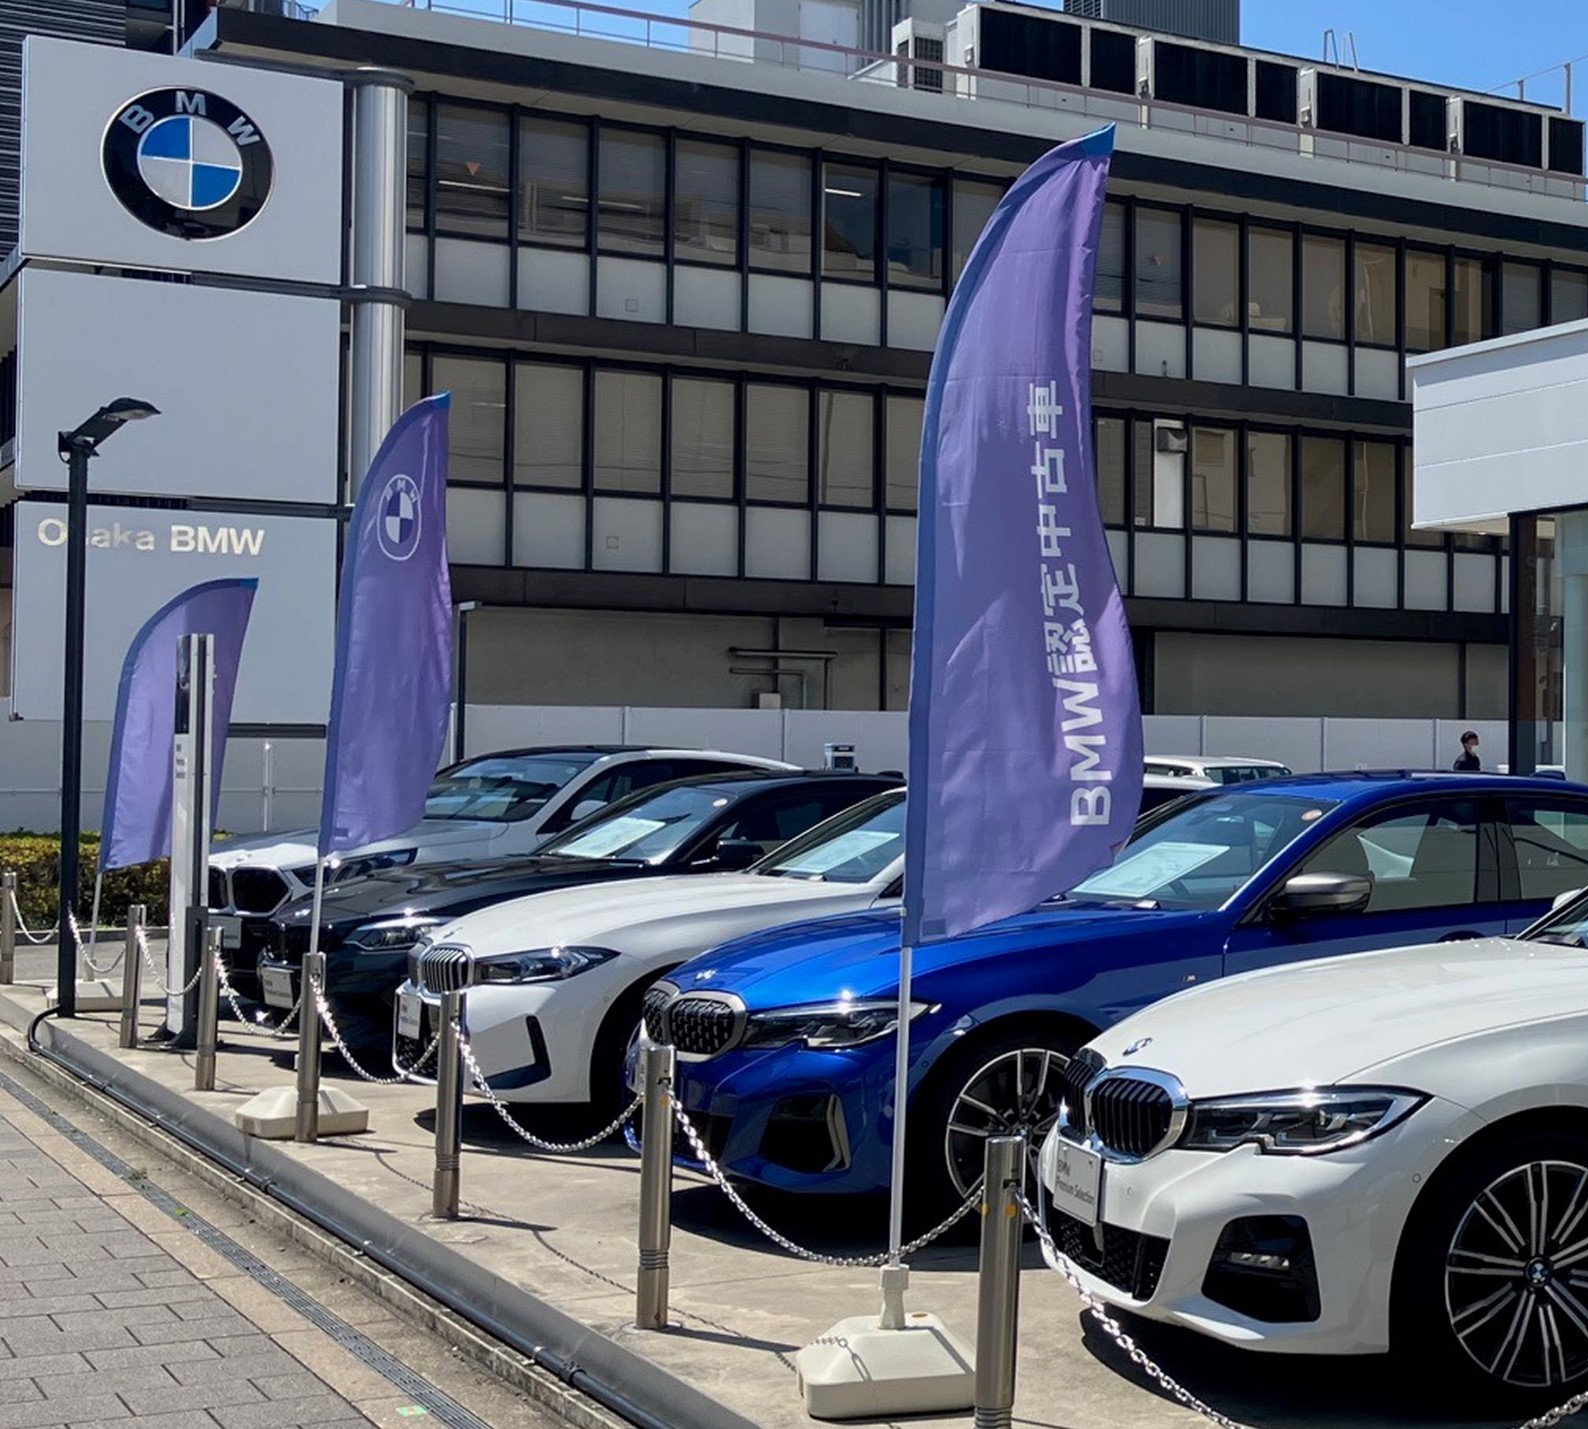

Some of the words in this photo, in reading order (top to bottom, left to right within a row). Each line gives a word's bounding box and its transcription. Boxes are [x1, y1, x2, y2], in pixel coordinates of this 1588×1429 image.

[119, 90, 261, 147] BMW
[37, 518, 155, 551] Oaka
[170, 524, 265, 555] BMW
[1027, 380, 1113, 826] BMW認定中古車
